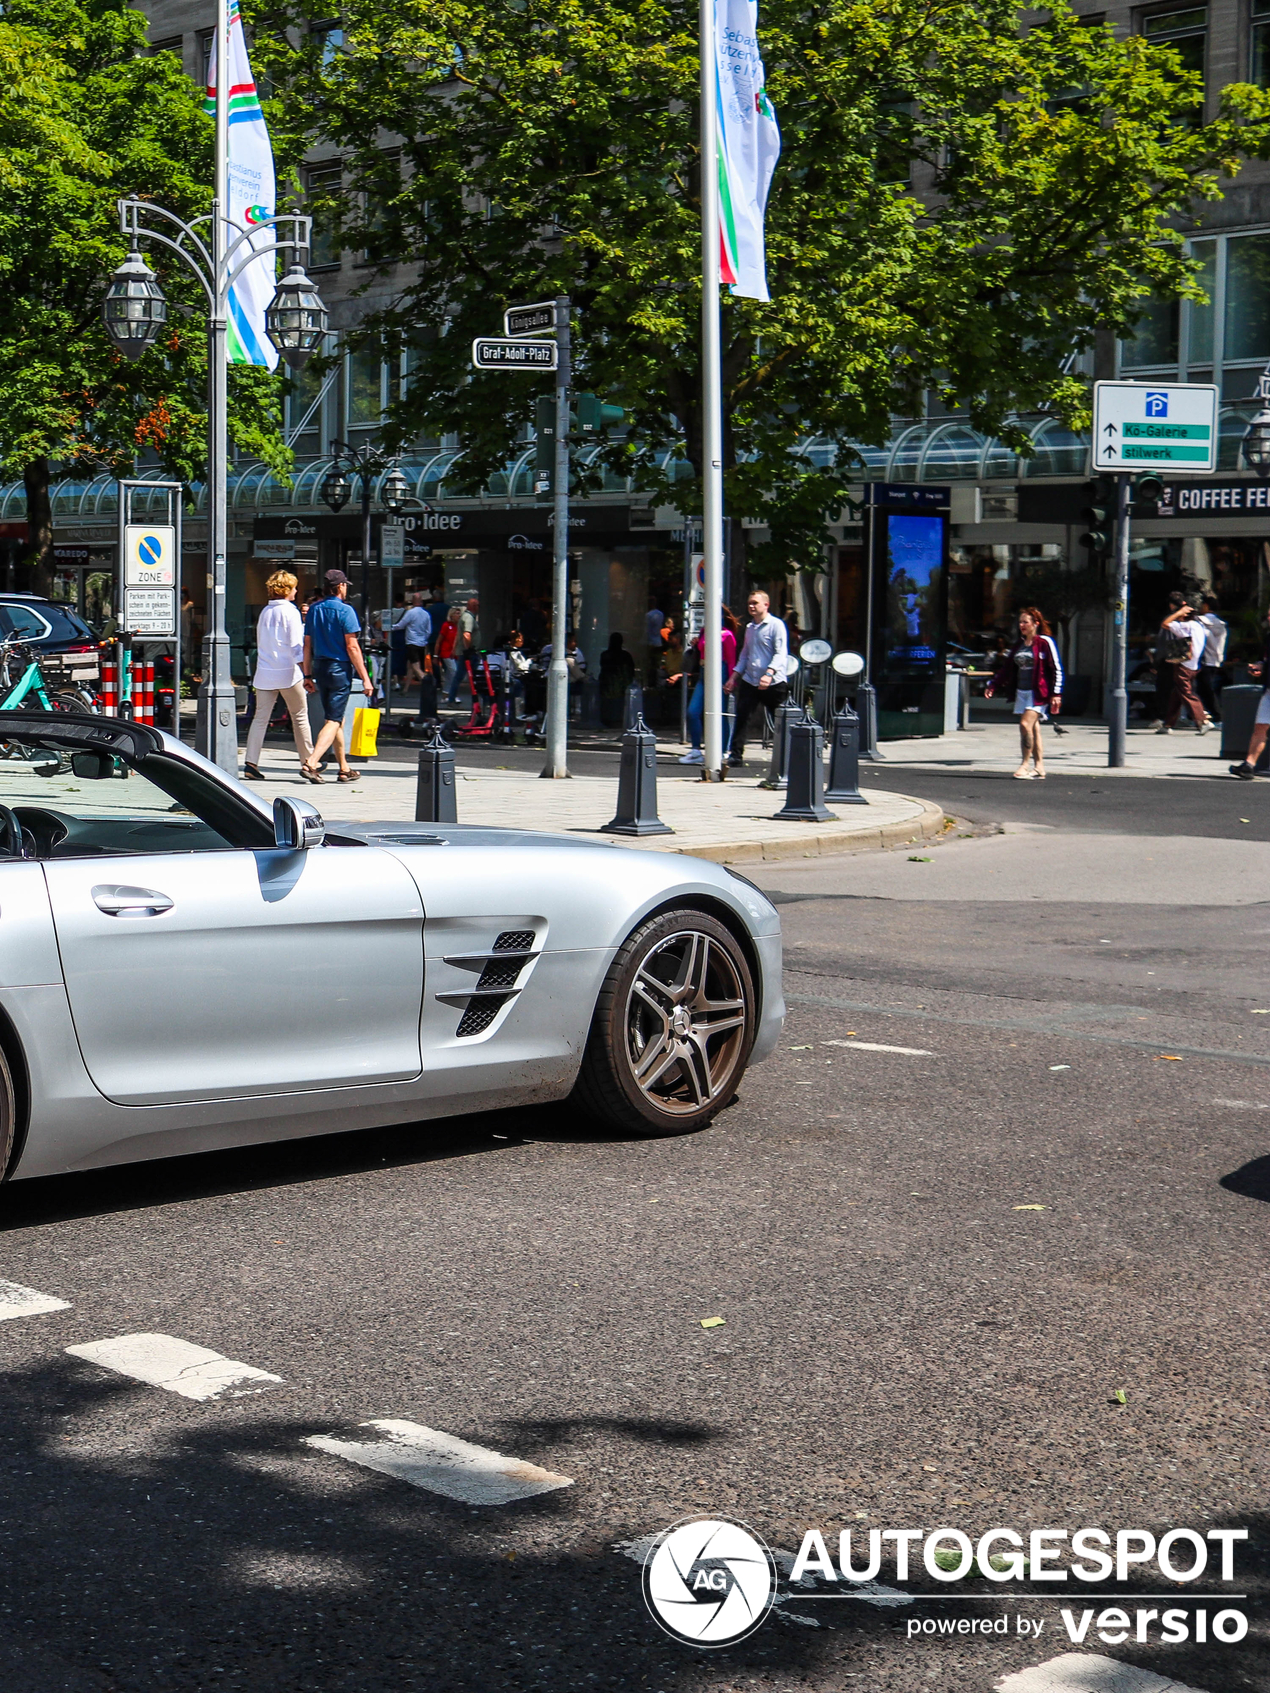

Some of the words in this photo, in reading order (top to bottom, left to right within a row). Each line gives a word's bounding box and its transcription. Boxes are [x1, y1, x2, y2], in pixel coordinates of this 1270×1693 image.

[483, 346, 550, 361] Graf-Adolf-Platz
[1125, 425, 1188, 438] Kö-Galerie
[1125, 446, 1172, 459] stilwerk
[1178, 489, 1242, 510] COFFEE
[138, 572, 162, 582] ZONE
[130, 592, 146, 600] Parken
[147, 592, 156, 600] mit
